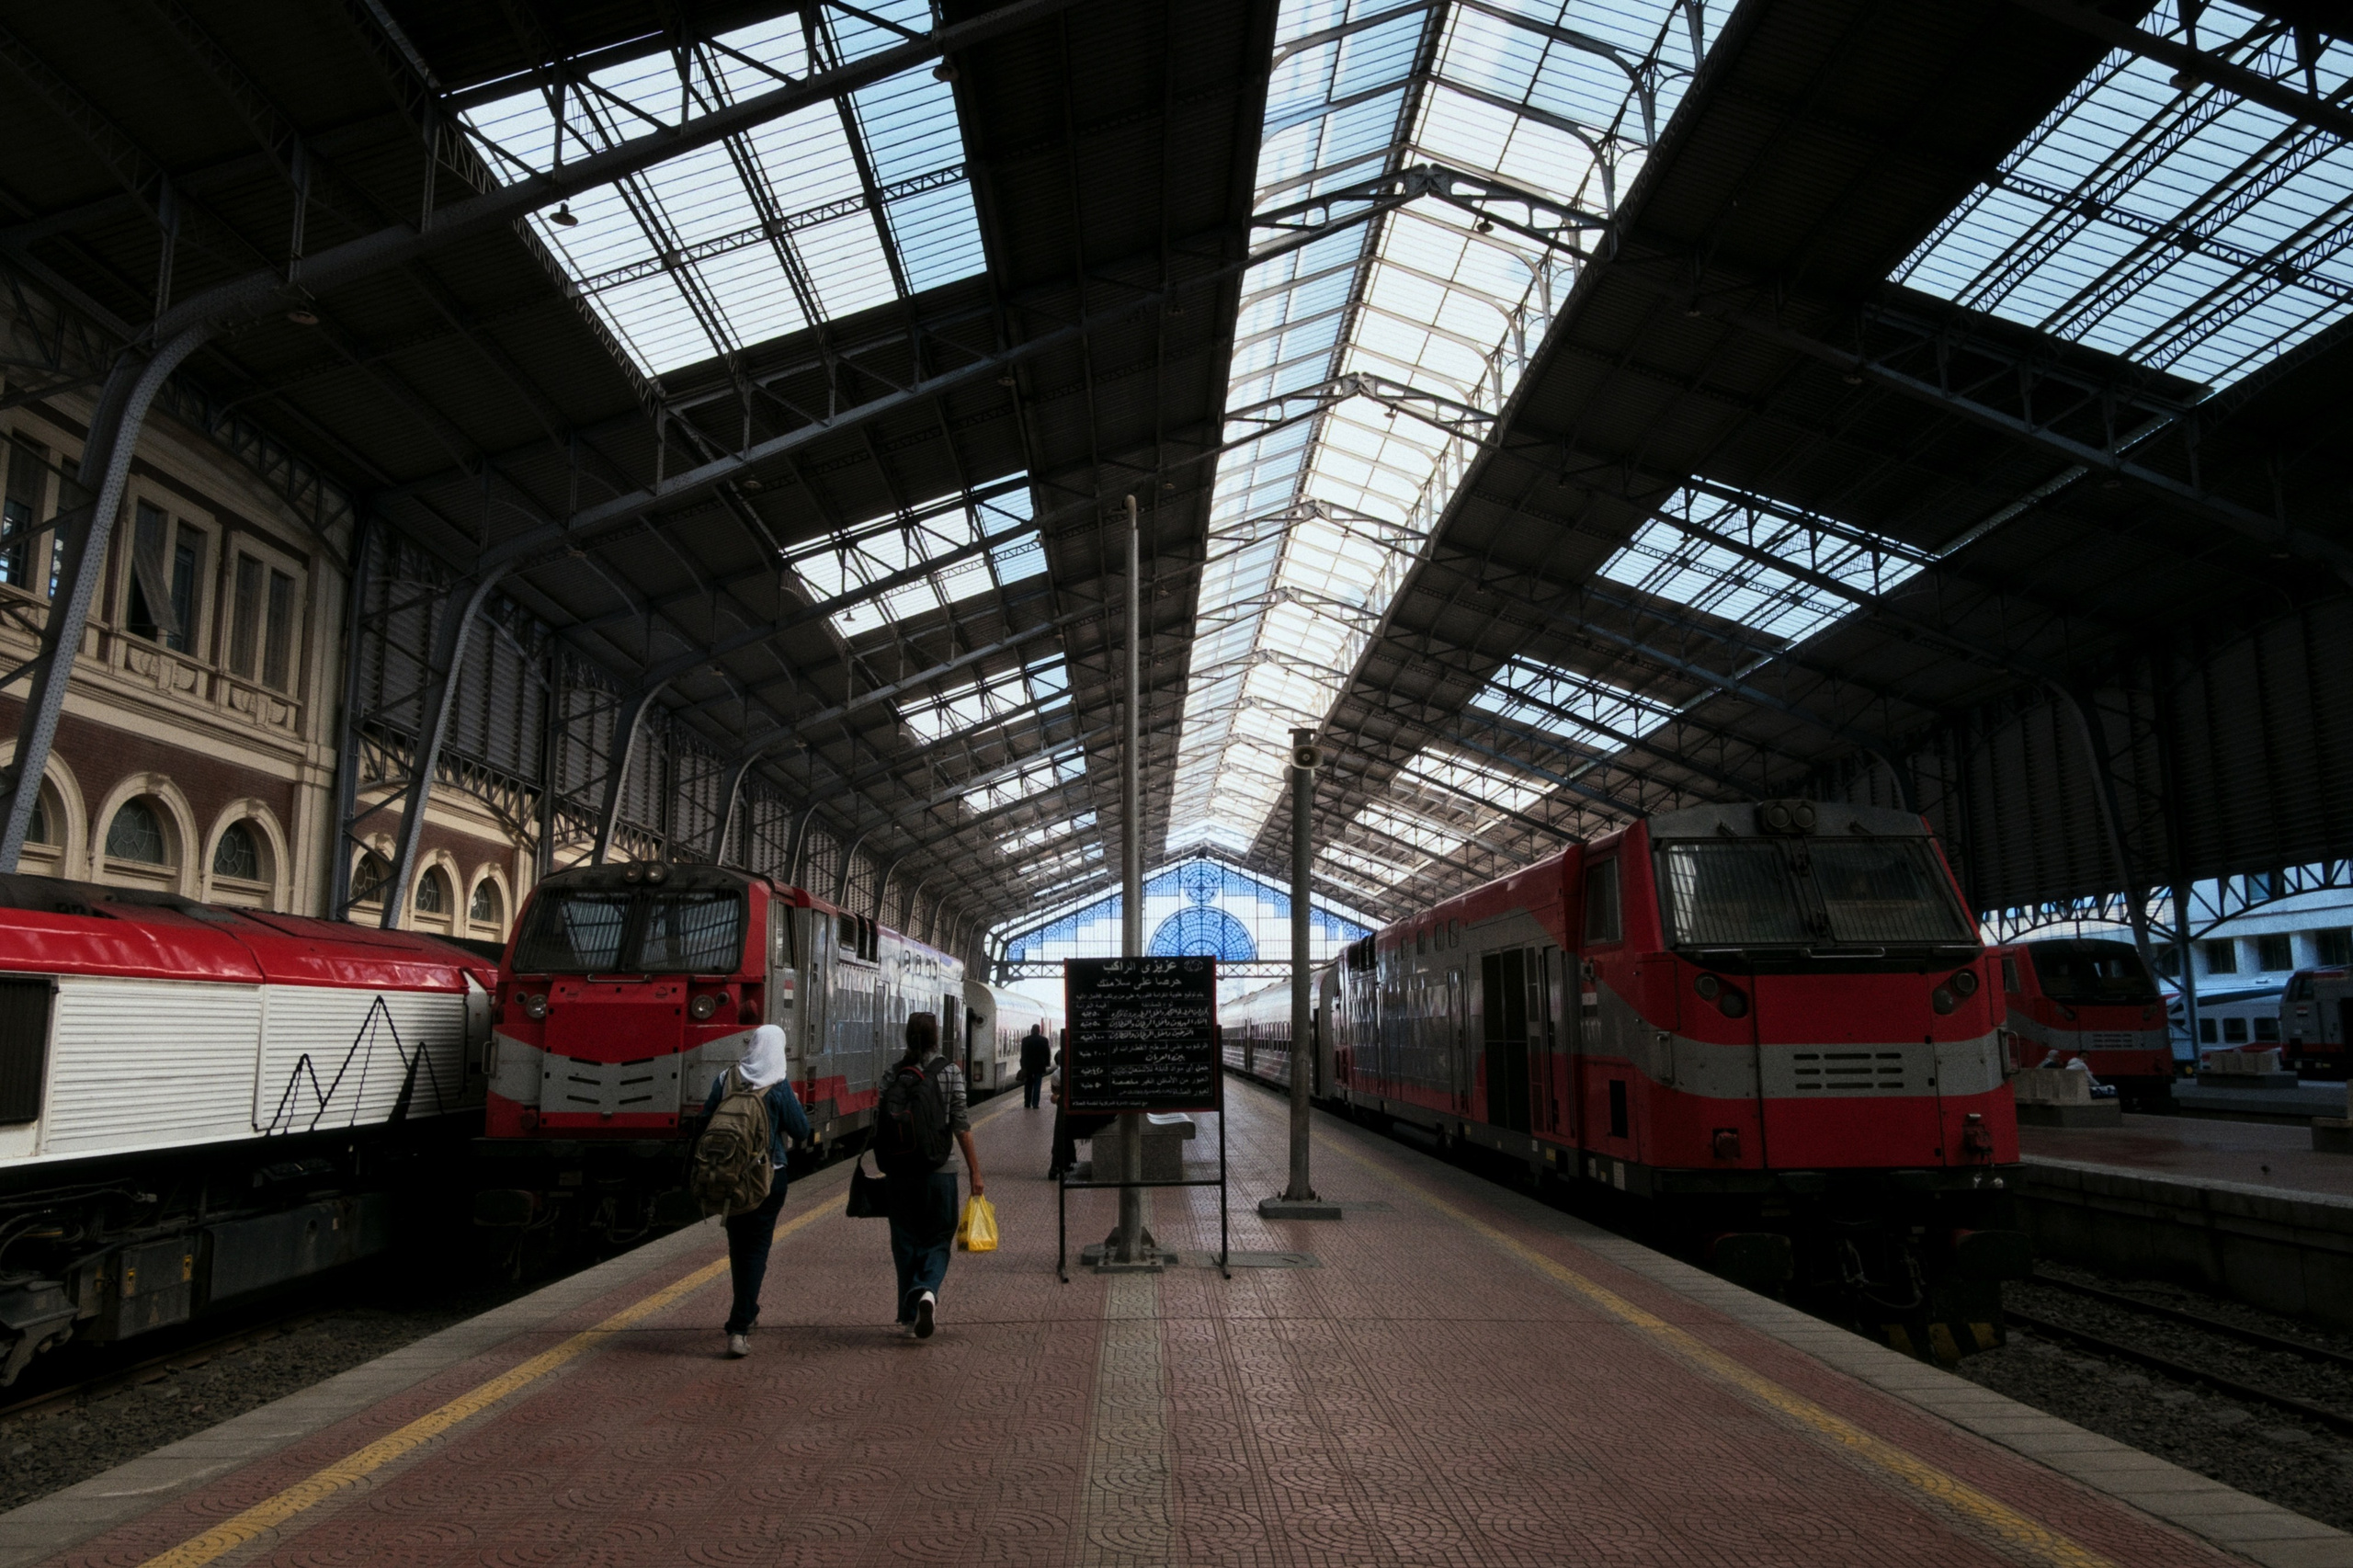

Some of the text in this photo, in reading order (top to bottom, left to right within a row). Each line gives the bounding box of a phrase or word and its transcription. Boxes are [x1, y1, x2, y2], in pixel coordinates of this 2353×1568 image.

[1103, 960, 1176, 974] عزيزى الراكب
[1097, 978, 1131, 988] سلامتك
[1155, 977, 1182, 987] حرصا
[1195, 1063, 1210, 1072] حمل
